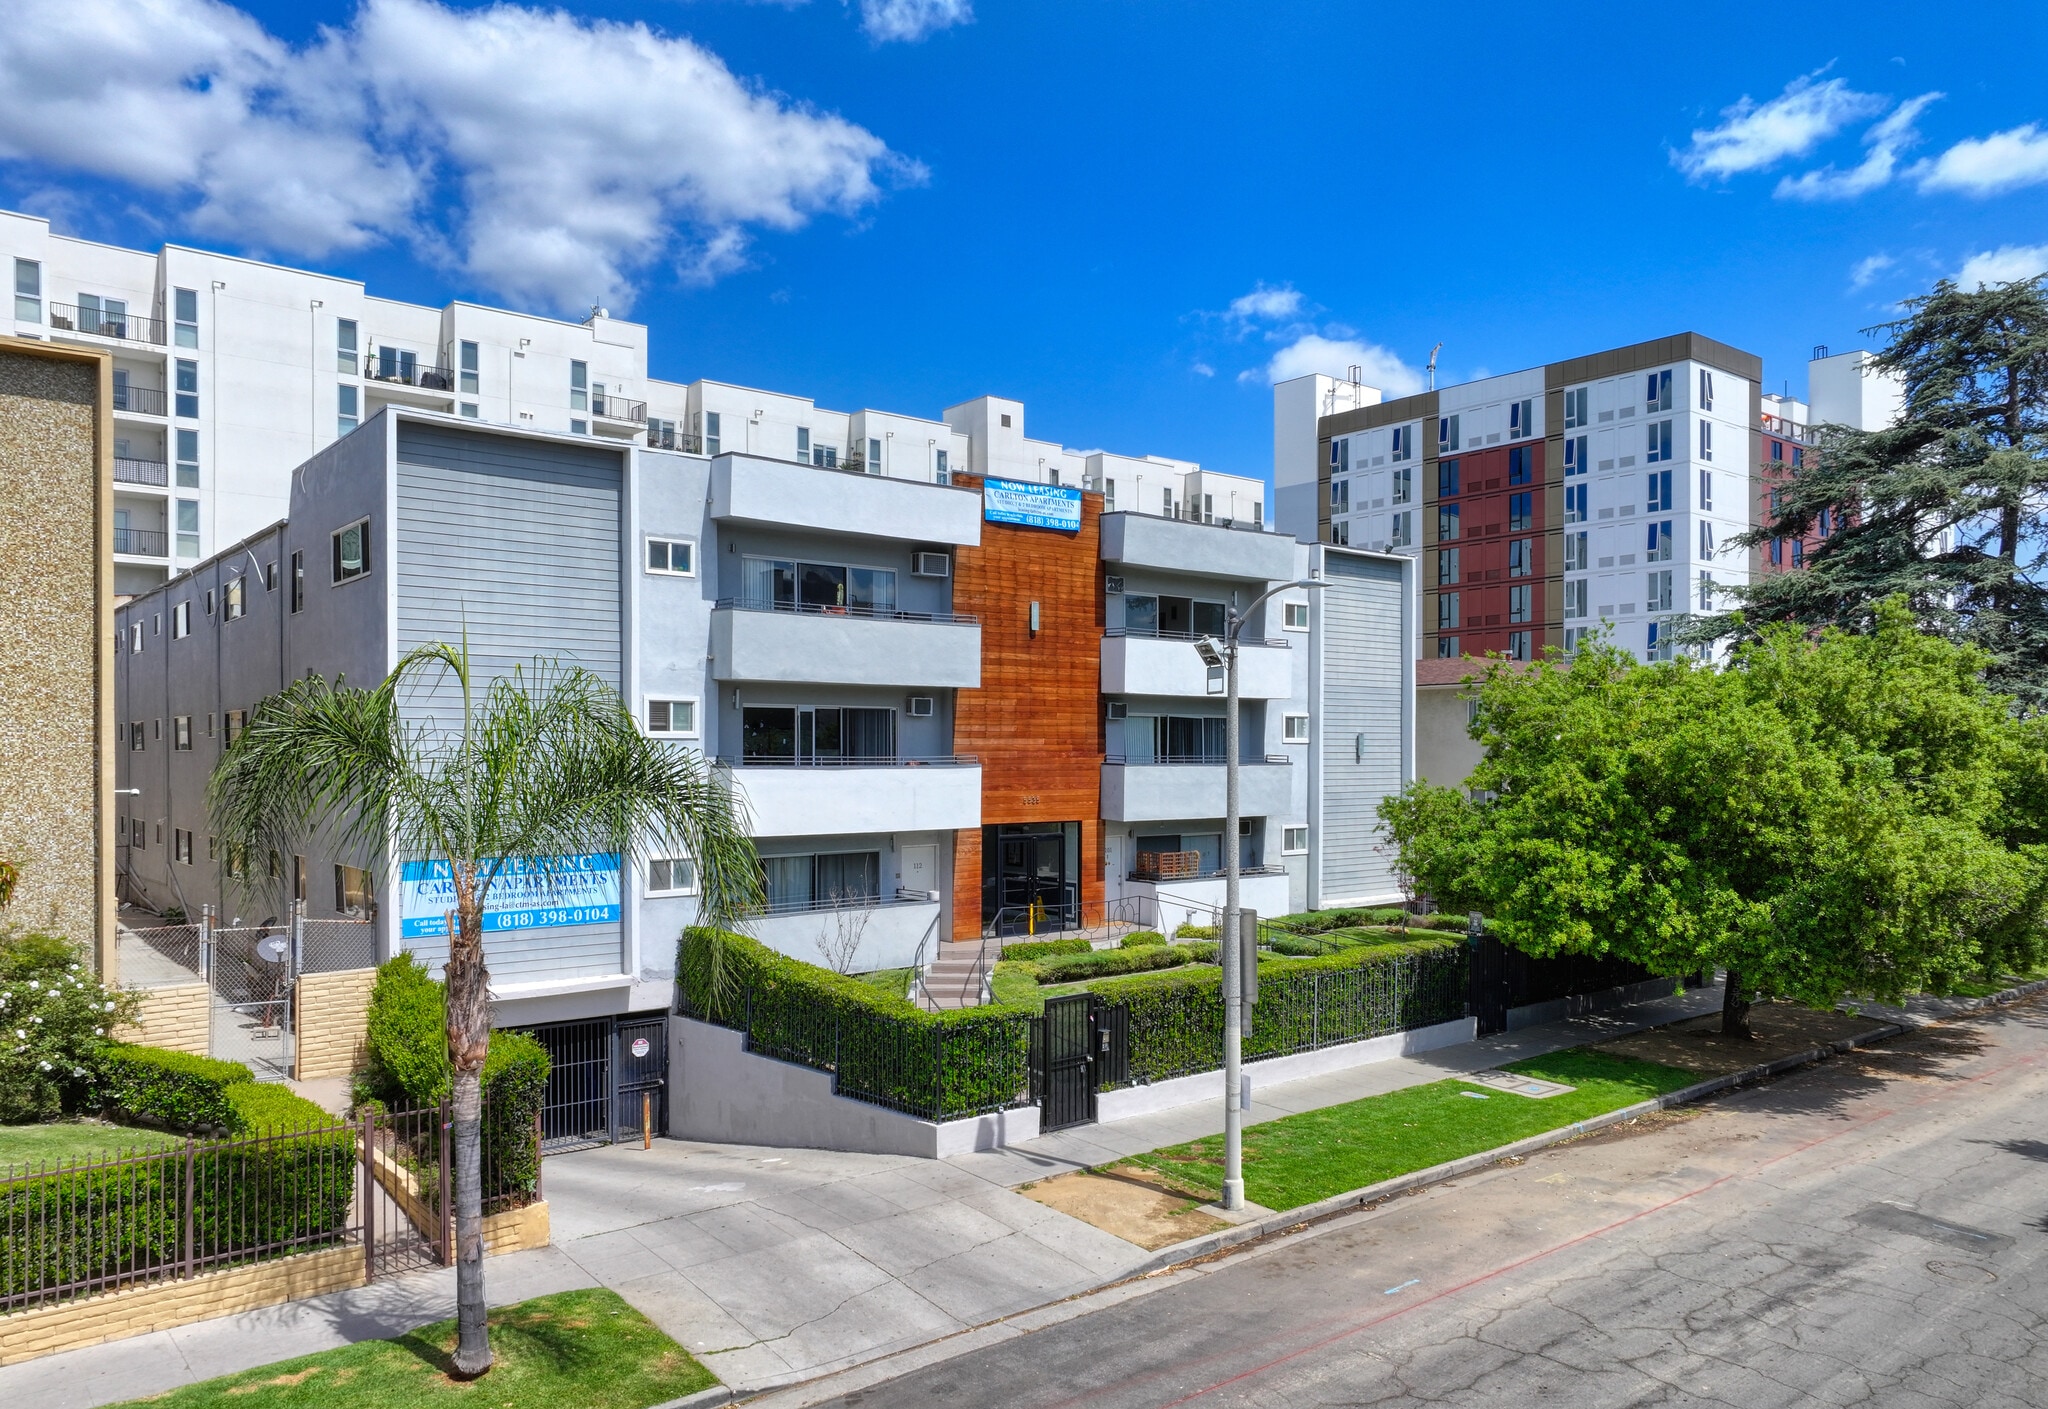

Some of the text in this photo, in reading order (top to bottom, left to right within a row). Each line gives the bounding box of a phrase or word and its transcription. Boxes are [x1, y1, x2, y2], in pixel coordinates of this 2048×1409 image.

[1000, 481, 1067, 499] NOW LEASING
[994, 490, 1028, 502] CARLTON
[1030, 496, 1075, 508] APARTMENTS
[1026, 515, 1044, 526] (818)
[418, 878, 500, 896] CARON
[428, 896, 458, 905] STUDI
[492, 889, 539, 901] BEDROOM
[482, 899, 559, 912] sing-la@ctm-as.com
[413, 919, 429, 927] Call
[497, 906, 610, 929] (818) 398-0104
[420, 926, 437, 935] your
